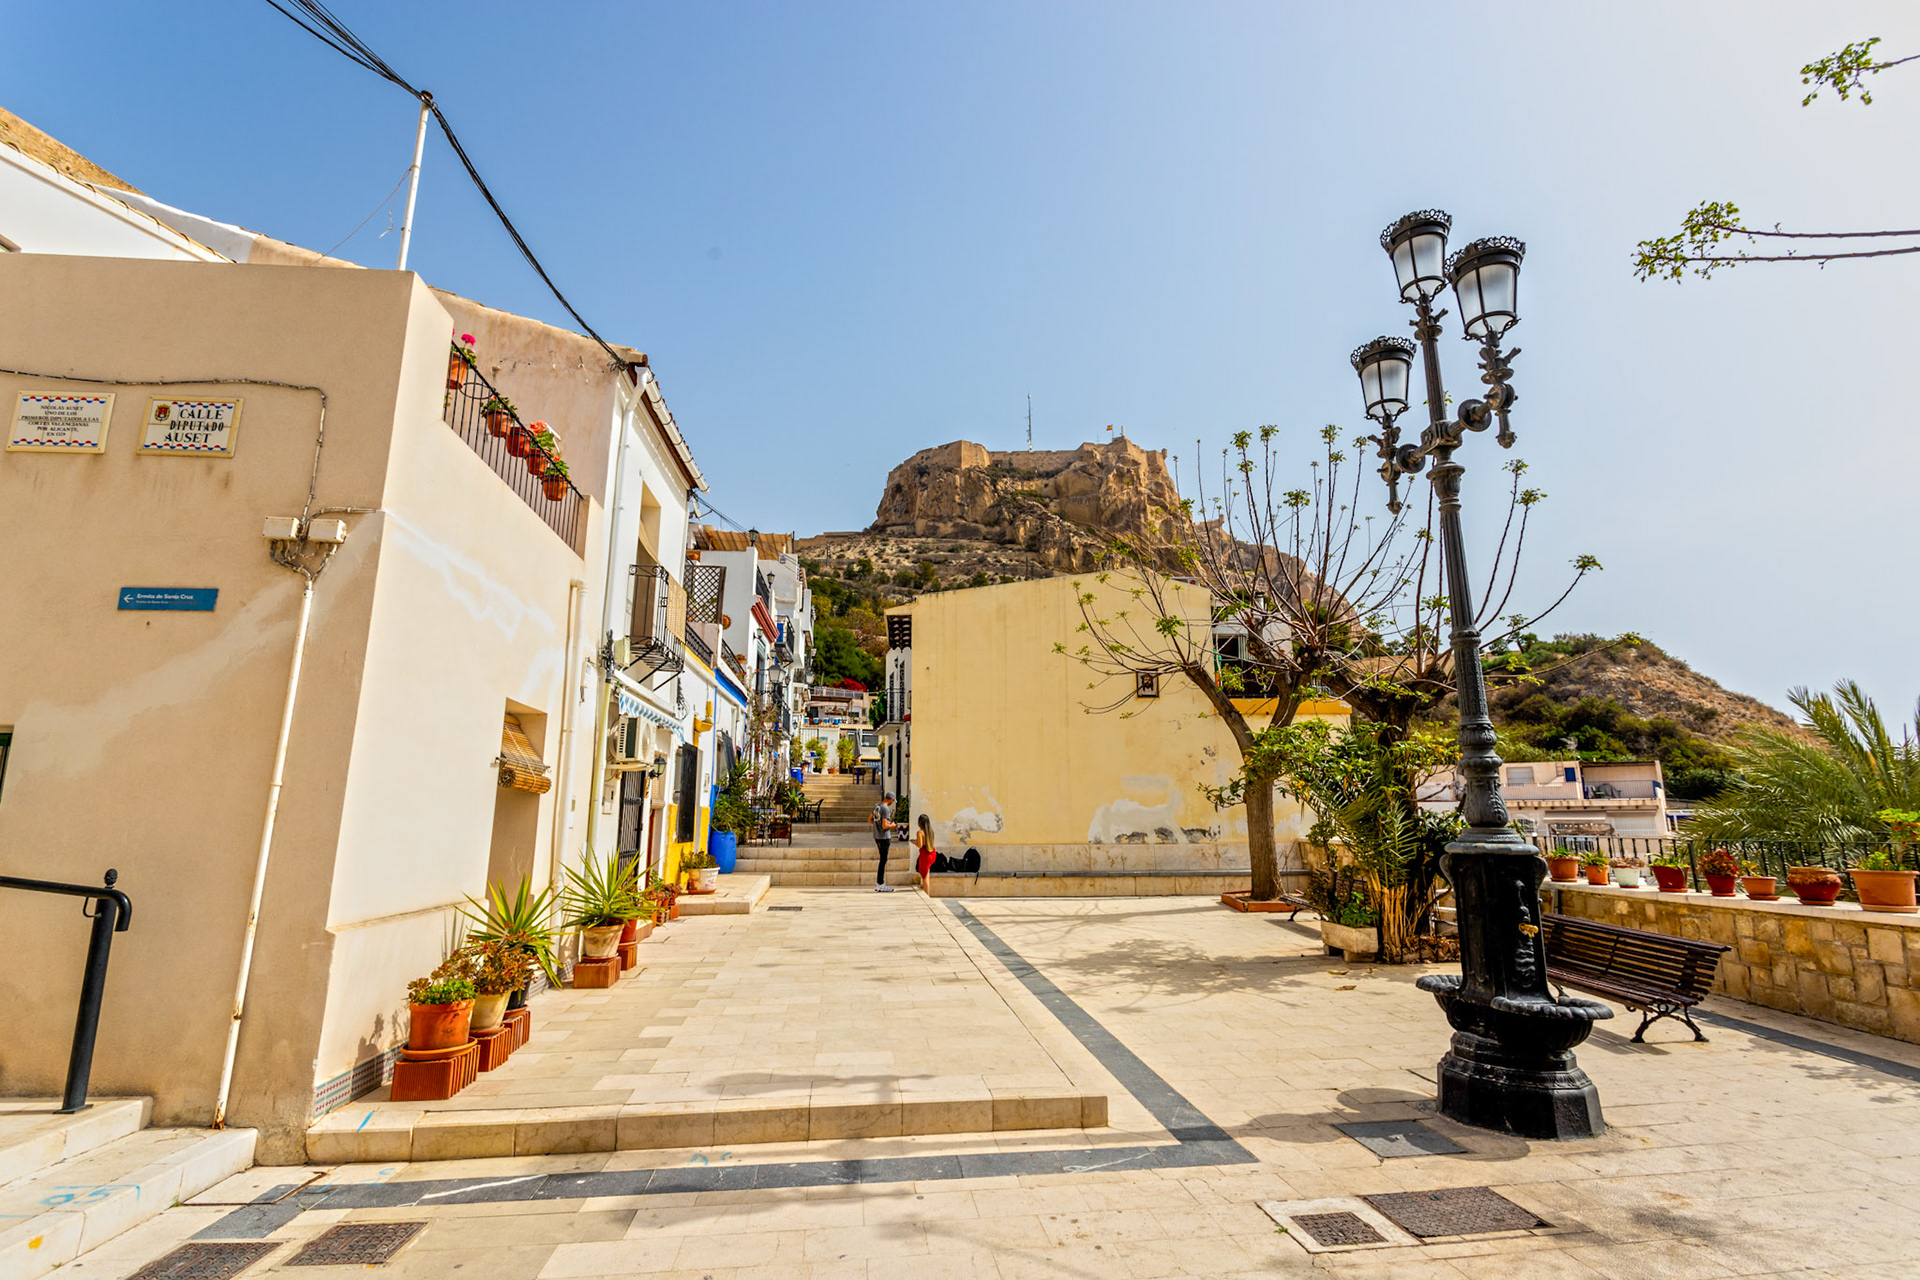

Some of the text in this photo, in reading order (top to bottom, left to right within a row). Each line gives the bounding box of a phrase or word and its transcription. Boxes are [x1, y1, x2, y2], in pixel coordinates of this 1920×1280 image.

[180, 408, 224, 420] CALLE
[170, 420, 224, 432] DIPUTADO
[164, 432, 211, 444] AUSET
